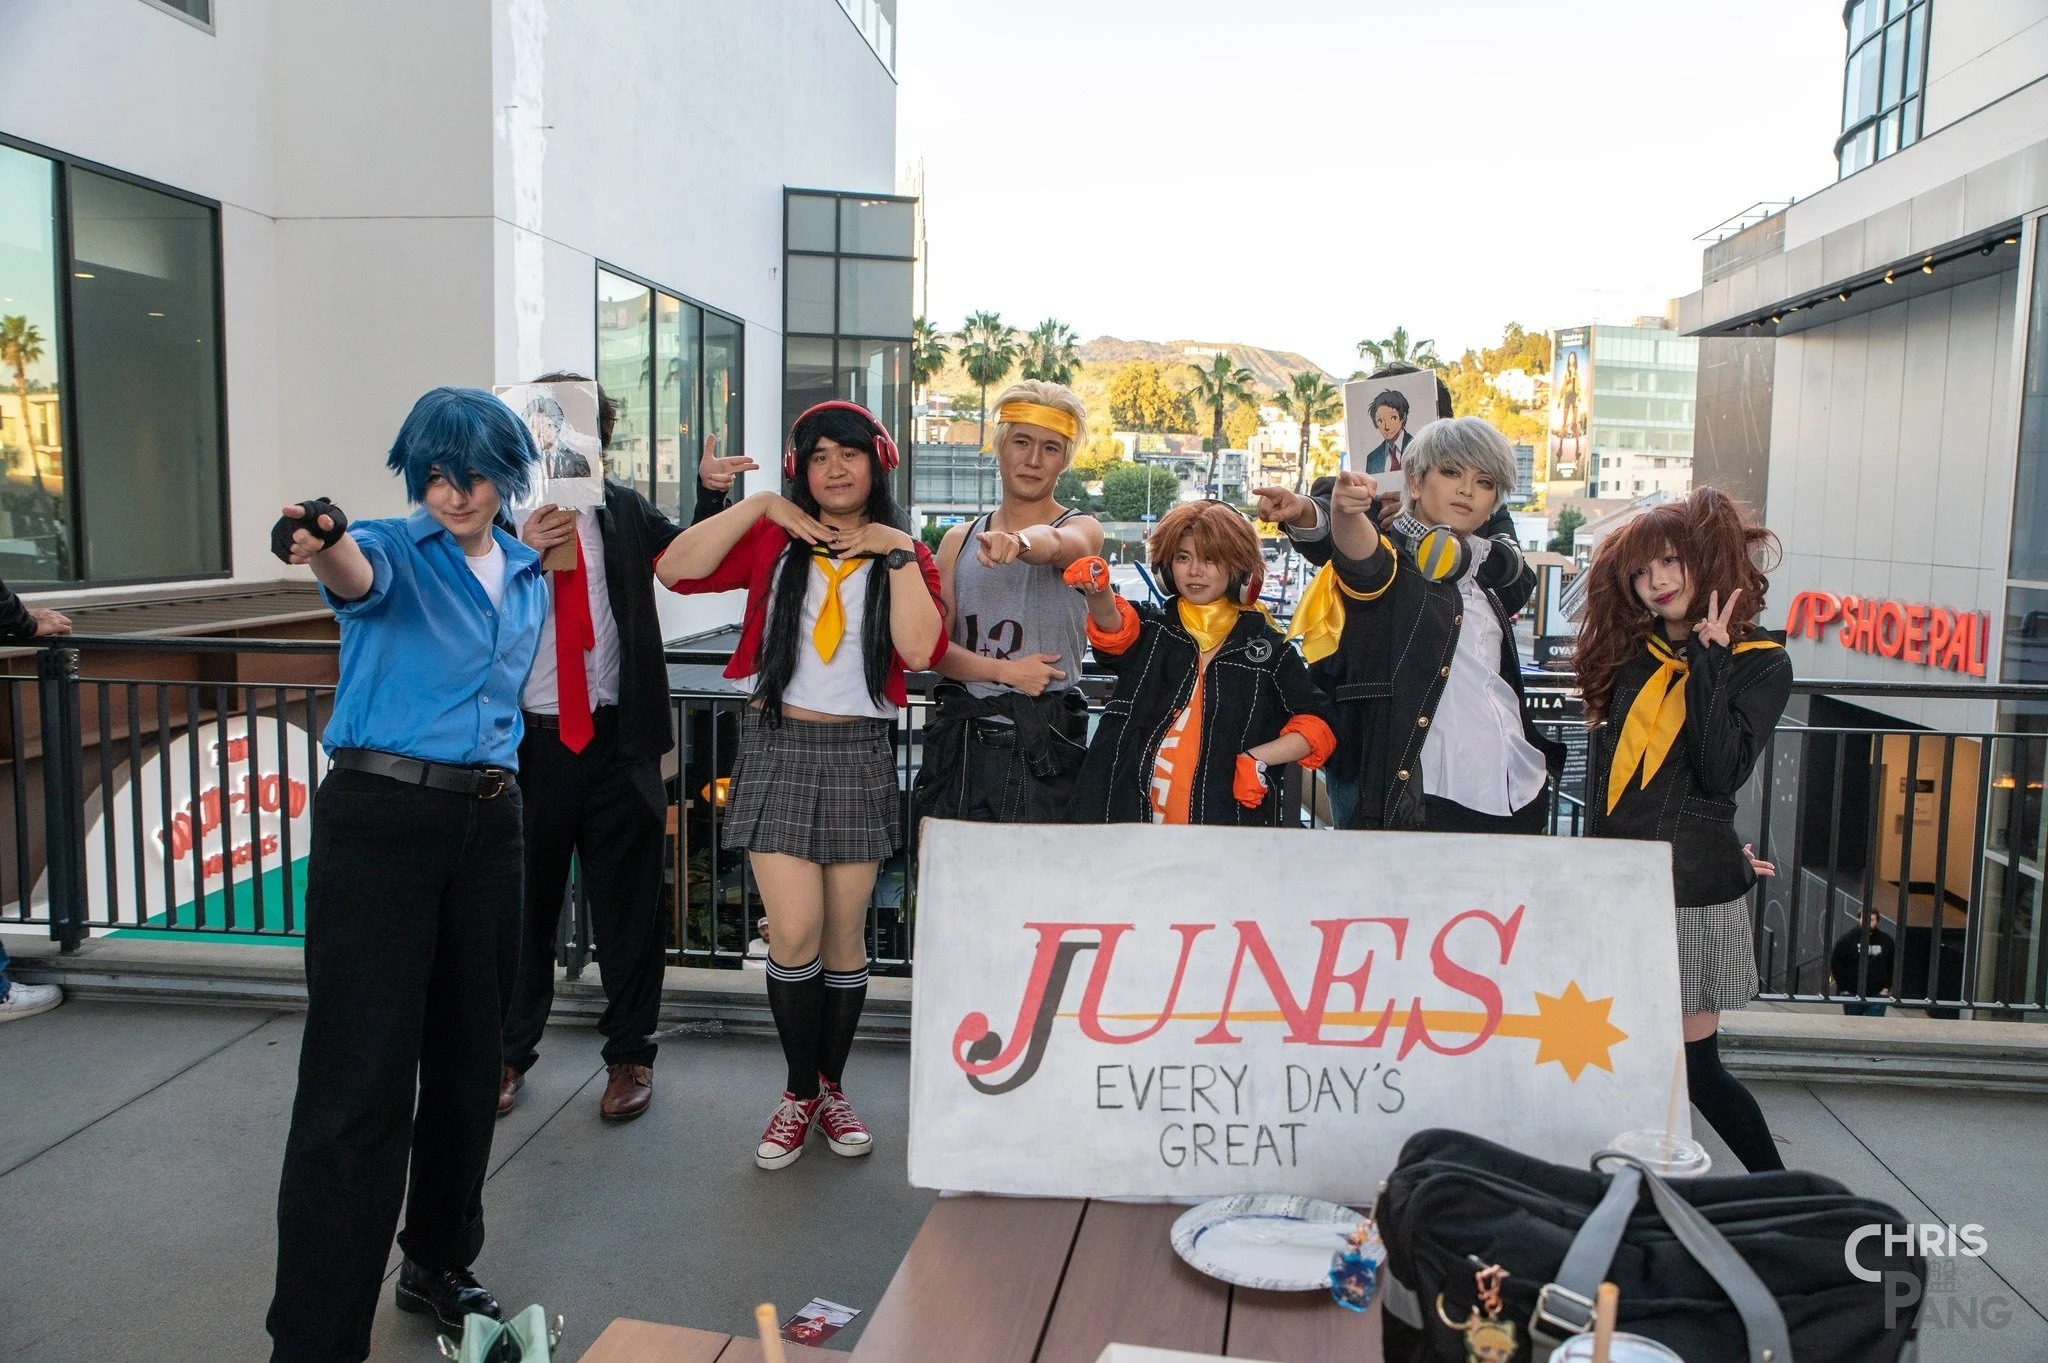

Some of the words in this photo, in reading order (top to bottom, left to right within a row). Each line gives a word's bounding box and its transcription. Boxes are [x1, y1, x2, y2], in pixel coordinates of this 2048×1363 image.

[952, 904, 1526, 1095] JUNES
[1096, 1063, 1248, 1115] EVERY
[1287, 1062, 1406, 1116] DAY'S
[1159, 1122, 1307, 1169] GREAT
